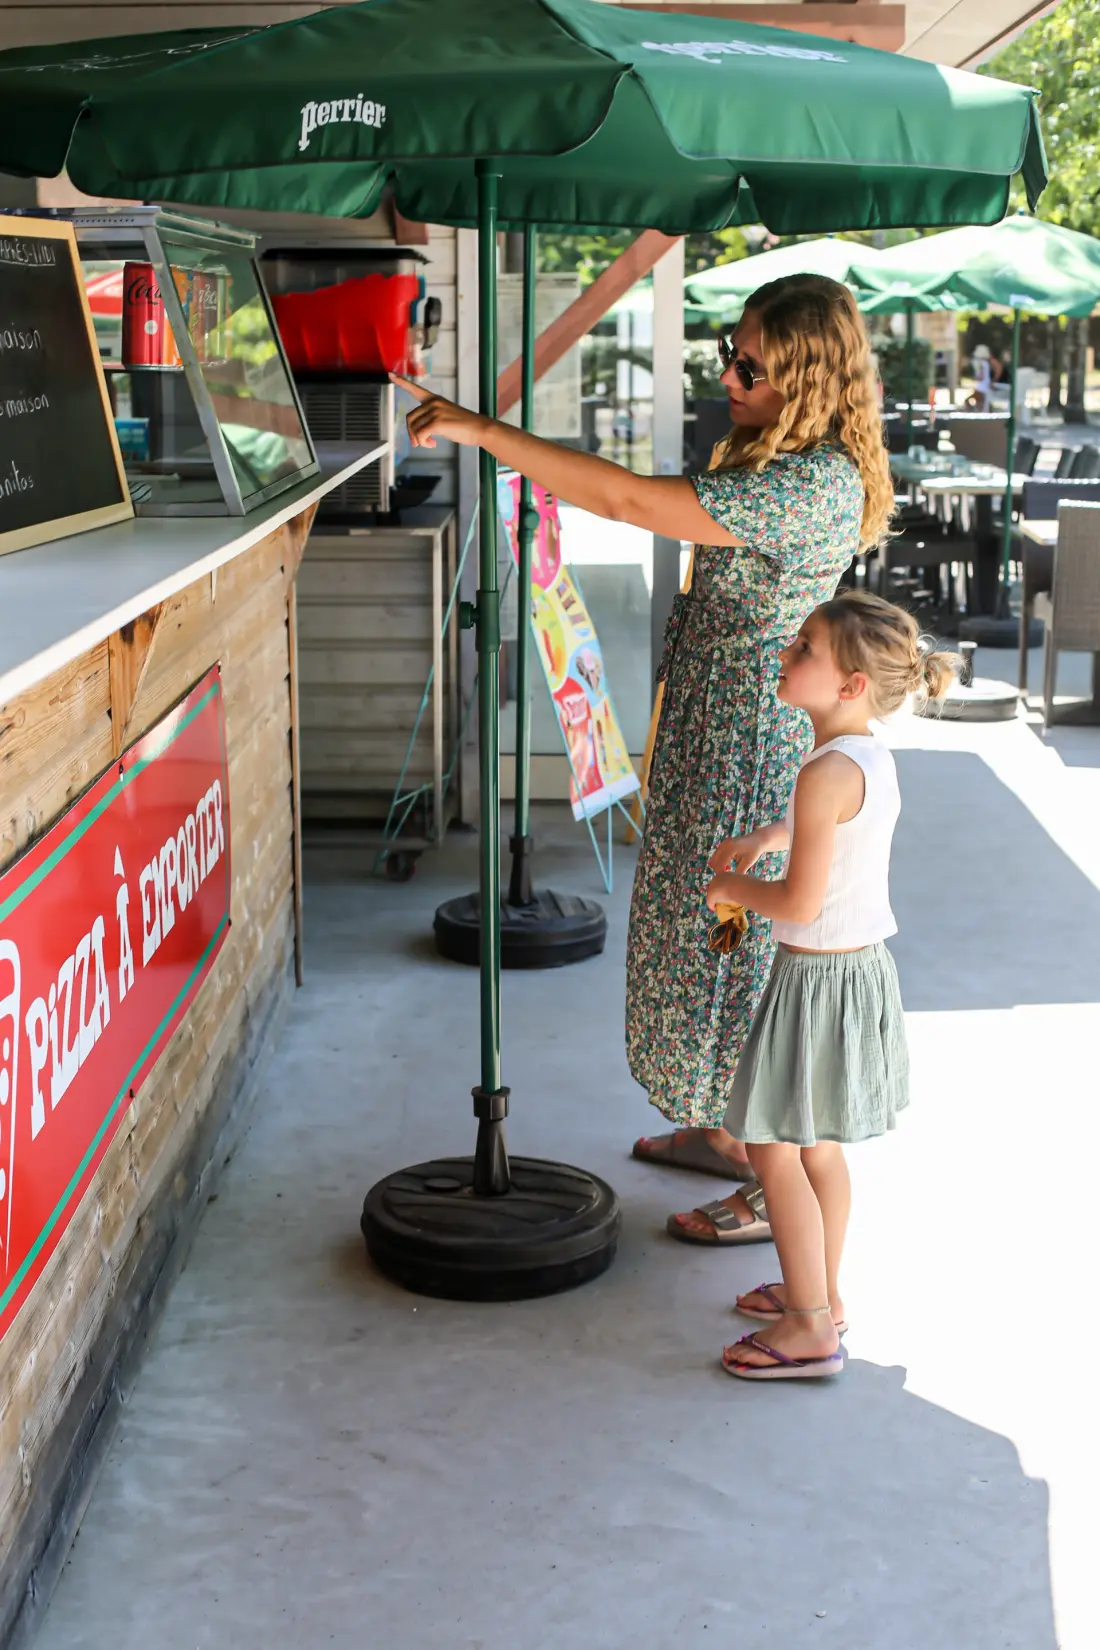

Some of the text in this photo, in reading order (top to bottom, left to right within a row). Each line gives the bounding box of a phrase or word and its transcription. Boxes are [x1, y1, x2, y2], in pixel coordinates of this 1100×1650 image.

[0, 322, 43, 355] aison
[6, 391, 50, 418] maison
[139, 779, 225, 968] EMPORTER
